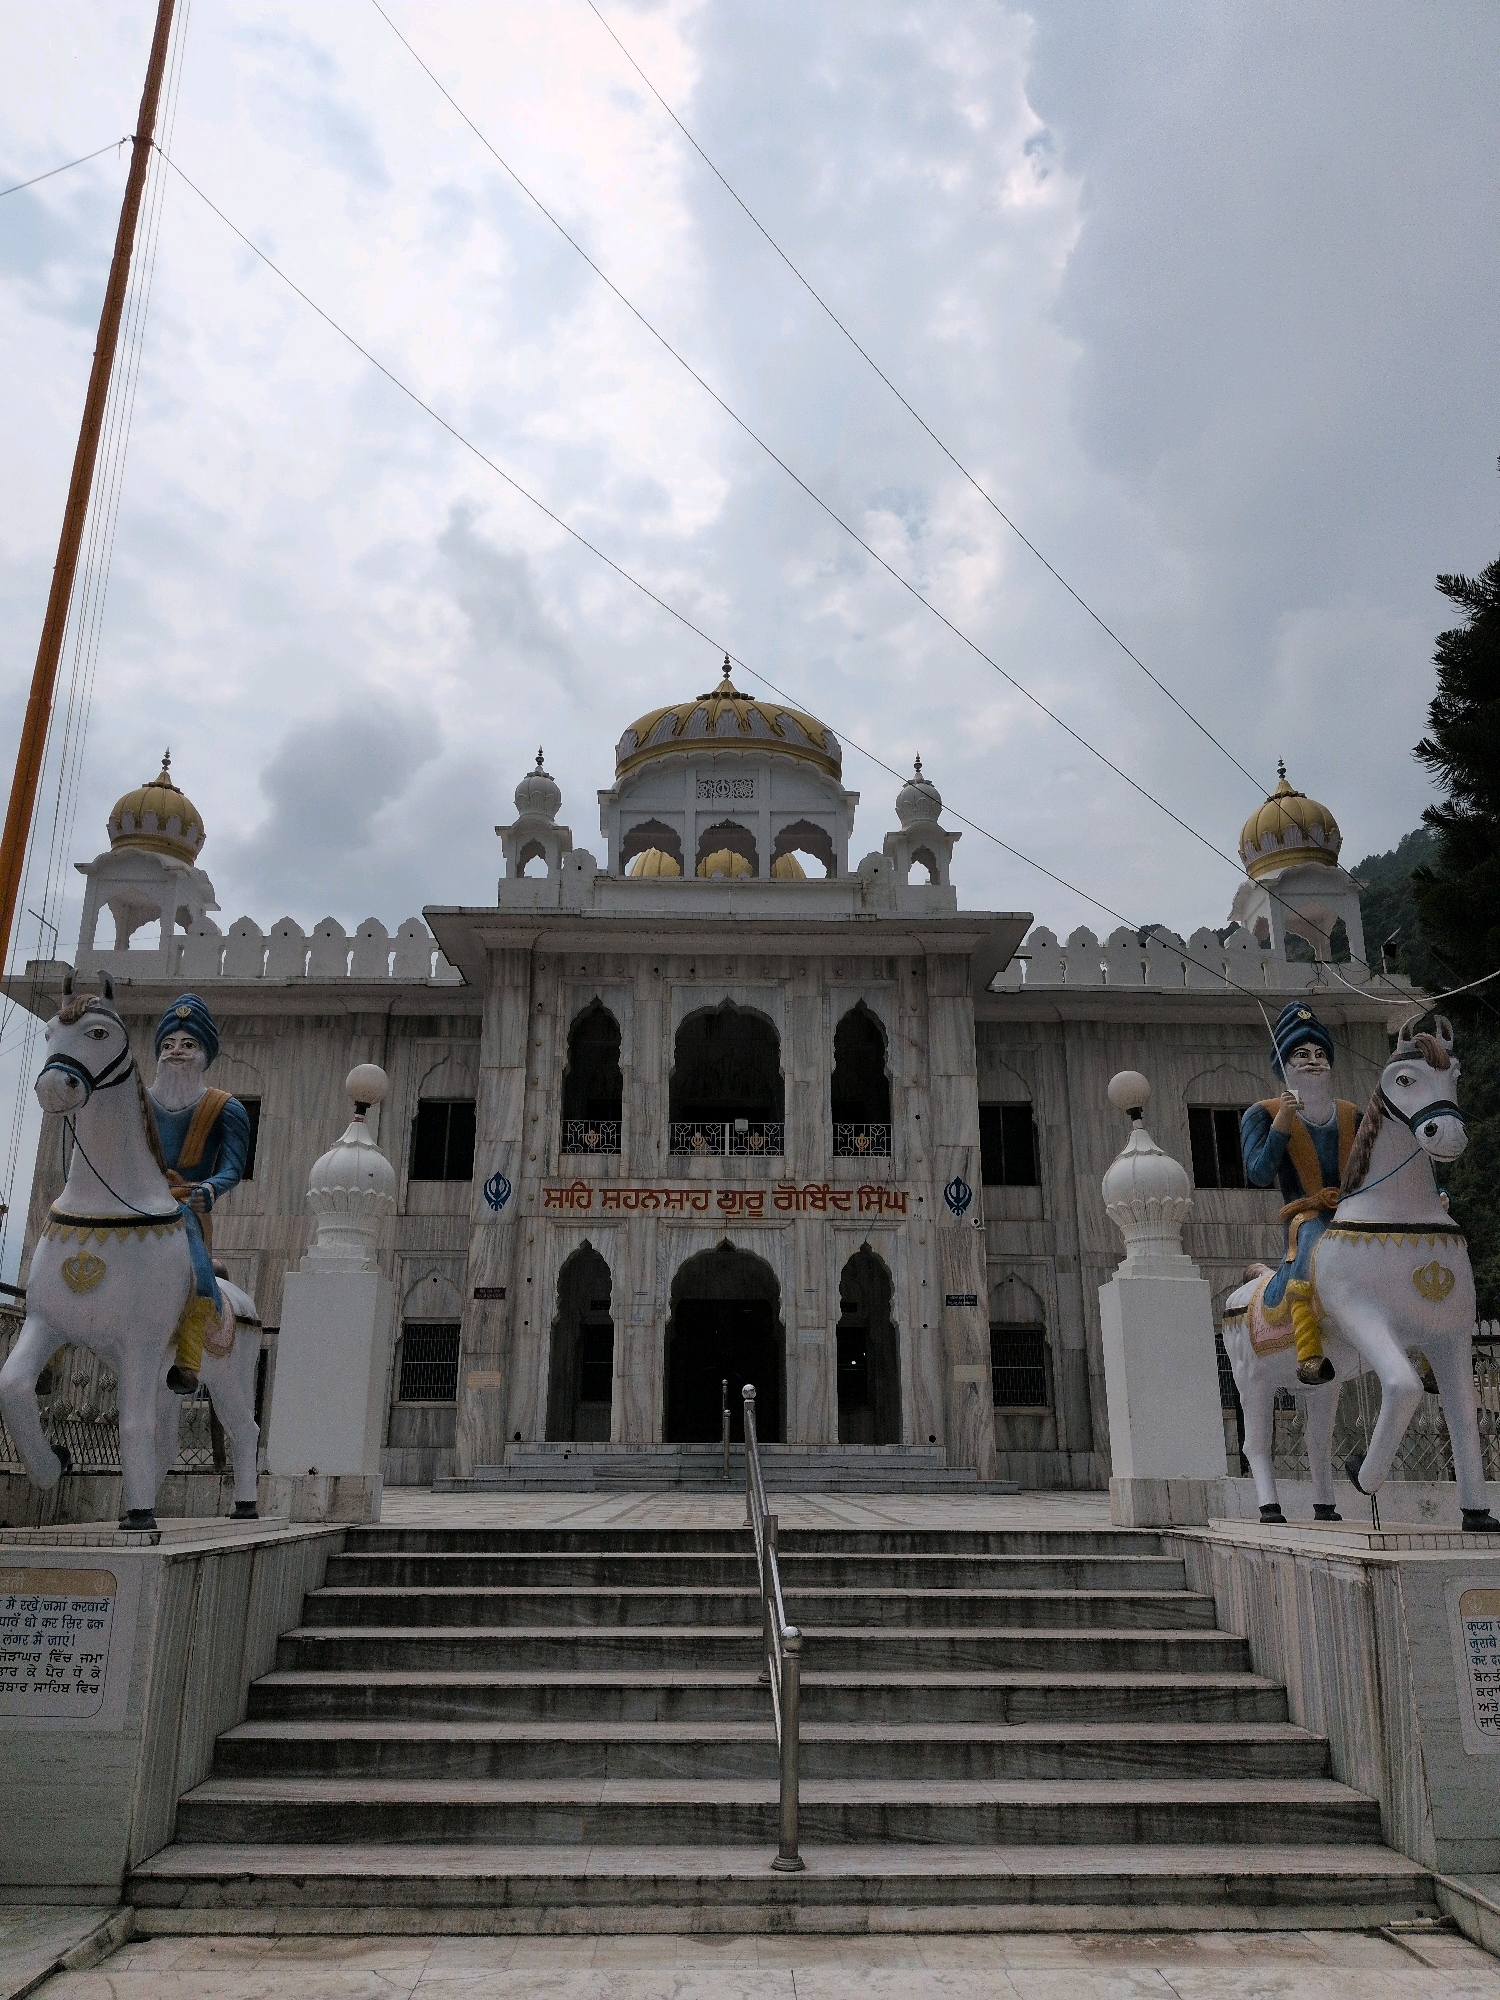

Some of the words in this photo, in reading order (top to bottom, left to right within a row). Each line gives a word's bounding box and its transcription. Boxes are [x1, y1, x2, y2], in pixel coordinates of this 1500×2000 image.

[543, 1181, 593, 1209] ਸ਼ਾਹਿ
[599, 1188, 712, 1211] ਸ਼ਹਨਸ਼ਾਹ
[717, 1190, 766, 1217] ਗੁਰੂ
[772, 1182, 853, 1212] ਗੋਬਿੰਦ
[857, 1184, 909, 1214] ਸਿੰਘ
[5, 1595, 17, 1610] में
[42, 1617, 59, 1628] कर
[62, 1614, 83, 1629] सिर
[3, 1629, 30, 1645] लंगर
[33, 1630, 44, 1645] में
[80, 1653, 104, 1663] ਜਮਾ
[1470, 1655, 1487, 1666] कर
[26, 1663, 37, 1677] ਕੇ
[46, 1663, 65, 1678] ਪੈਰ
[91, 1665, 102, 1679] ਕੇ
[34, 1679, 71, 1693] ਸਾਹਿਬ
[1478, 1698, 1499, 1712] ਅਤੇ
